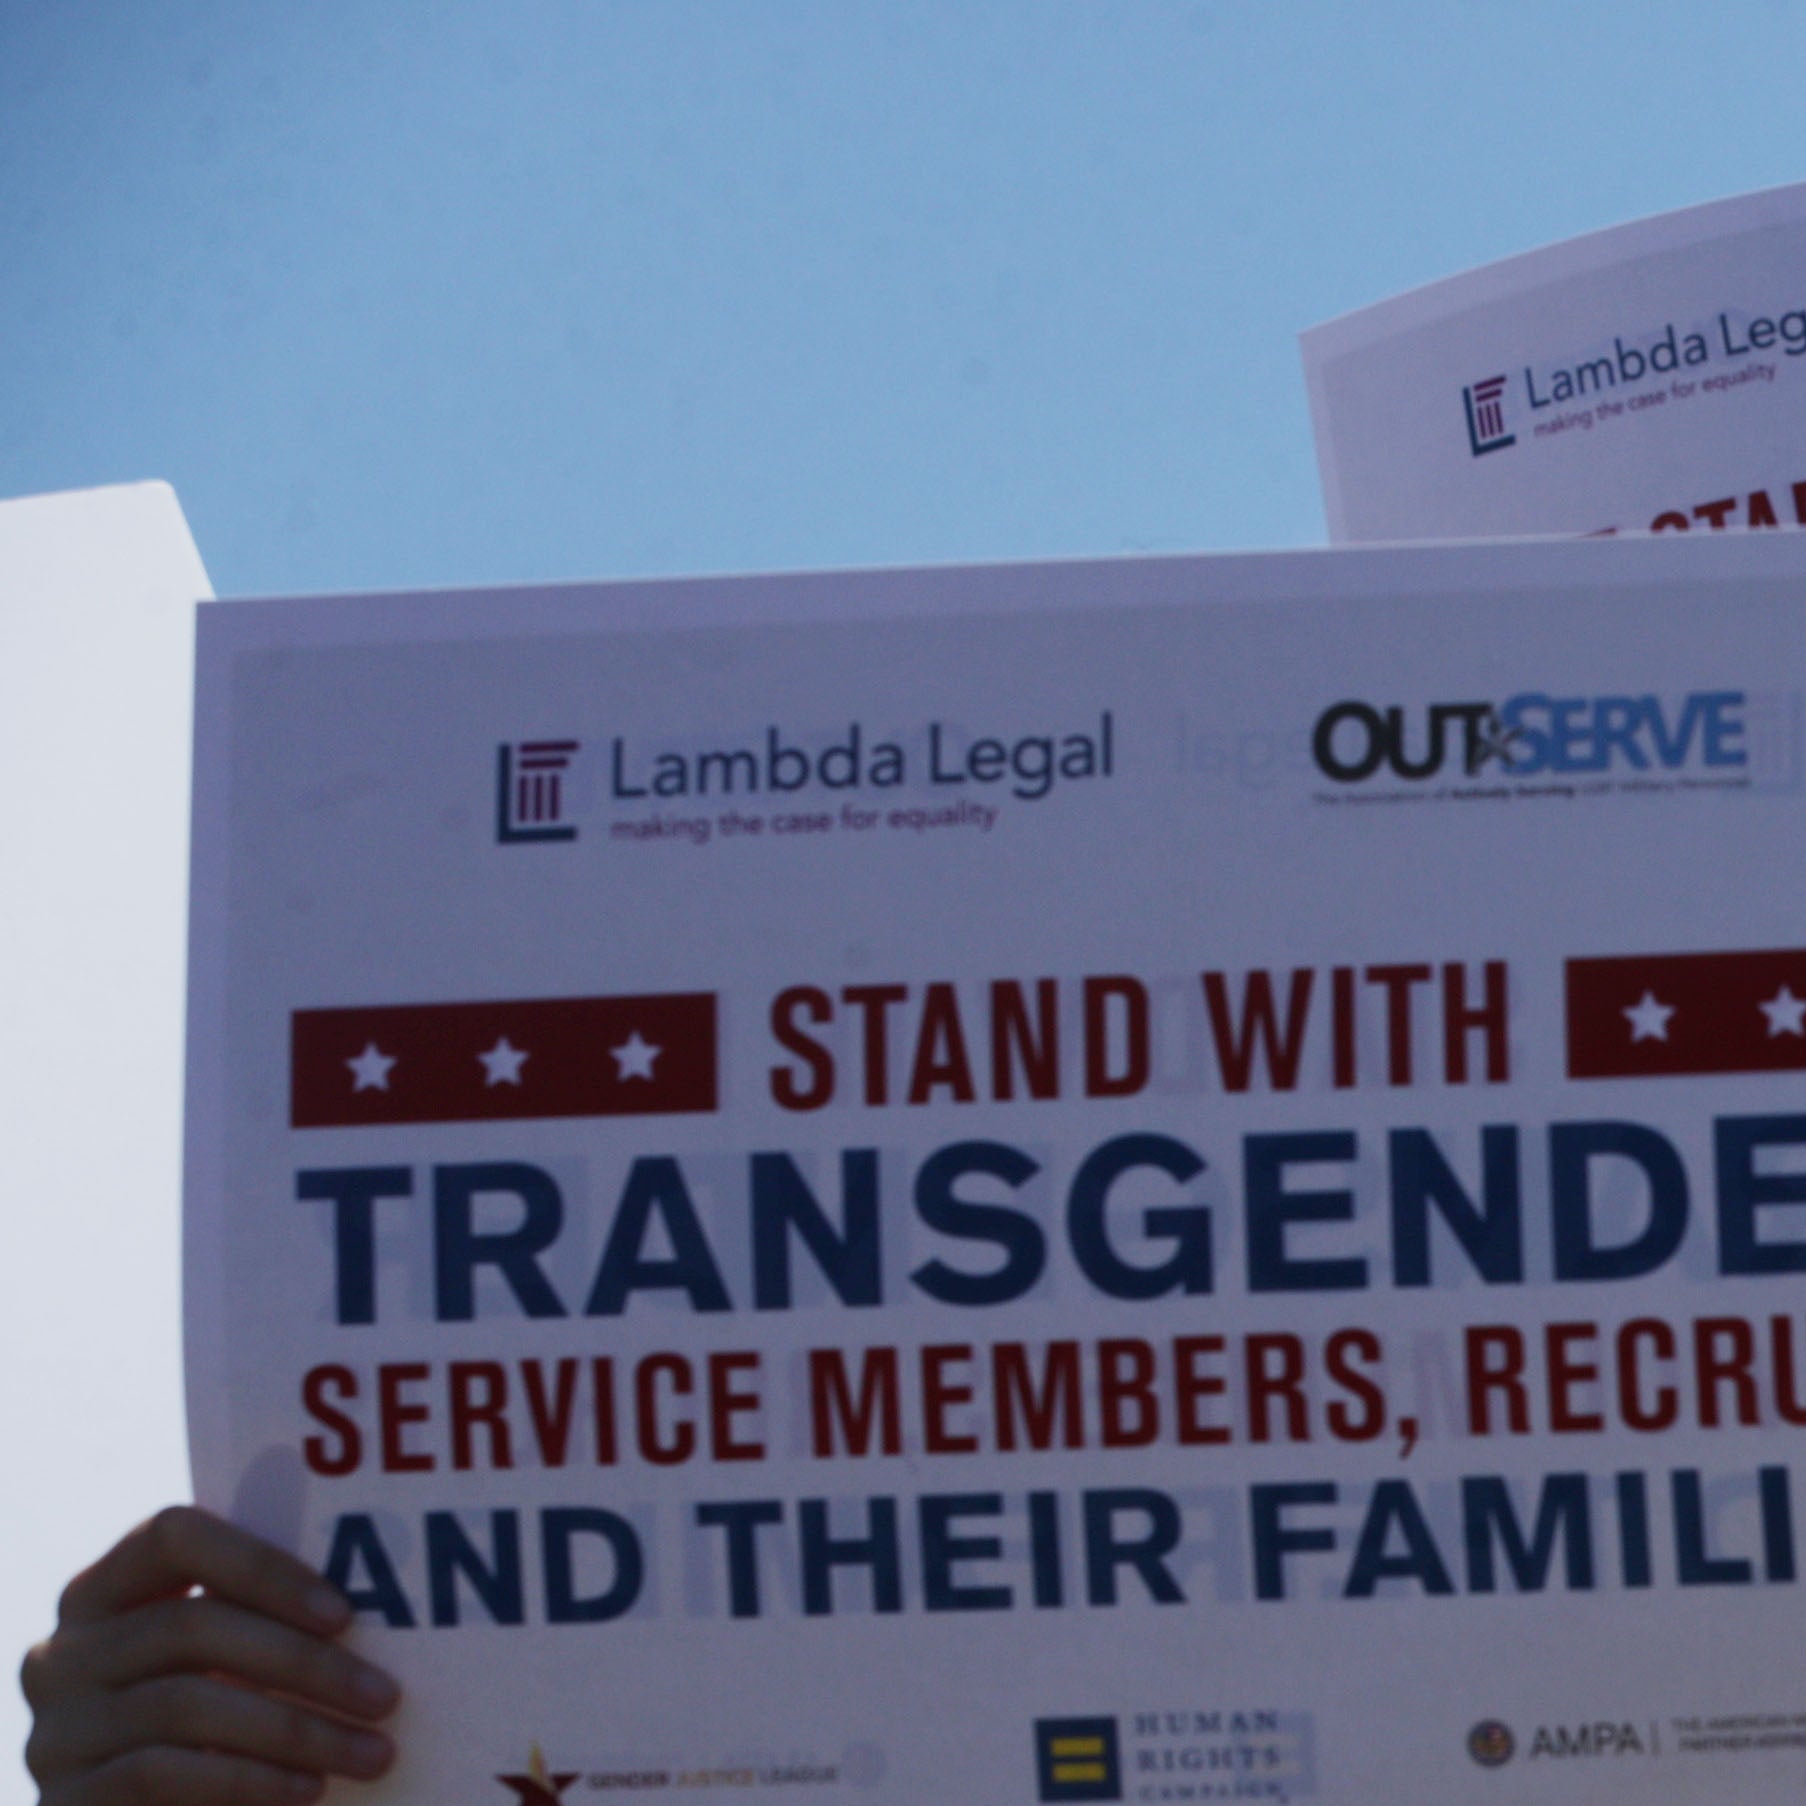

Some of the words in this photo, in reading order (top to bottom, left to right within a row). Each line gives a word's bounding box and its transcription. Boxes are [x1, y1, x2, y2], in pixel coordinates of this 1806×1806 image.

[1525, 322, 1709, 410] Lambda
[1533, 406, 1593, 438] making
[1597, 399, 1624, 421] the
[1628, 390, 1667, 412] case
[1670, 378, 1698, 401] for
[1702, 361, 1778, 394] equality
[612, 723, 906, 799] Lambda
[930, 711, 1114, 800] Legal
[611, 811, 708, 843] making
[718, 808, 763, 835] the
[770, 809, 832, 834] case
[841, 804, 880, 832] for
[890, 798, 998, 834] equality
[769, 975, 1153, 1113] STAND
[1201, 960, 1510, 1093] WITH
[301, 1350, 767, 1477] SERVICE
[808, 1326, 1421, 1461] MEMBERS,
[318, 1504, 647, 1630] AND
[694, 1486, 1188, 1619] THEIR
[1134, 1710, 1279, 1736] HUMAN
[1137, 1745, 1281, 1772] RIGHTS
[1529, 1721, 1644, 1760] AMPA
